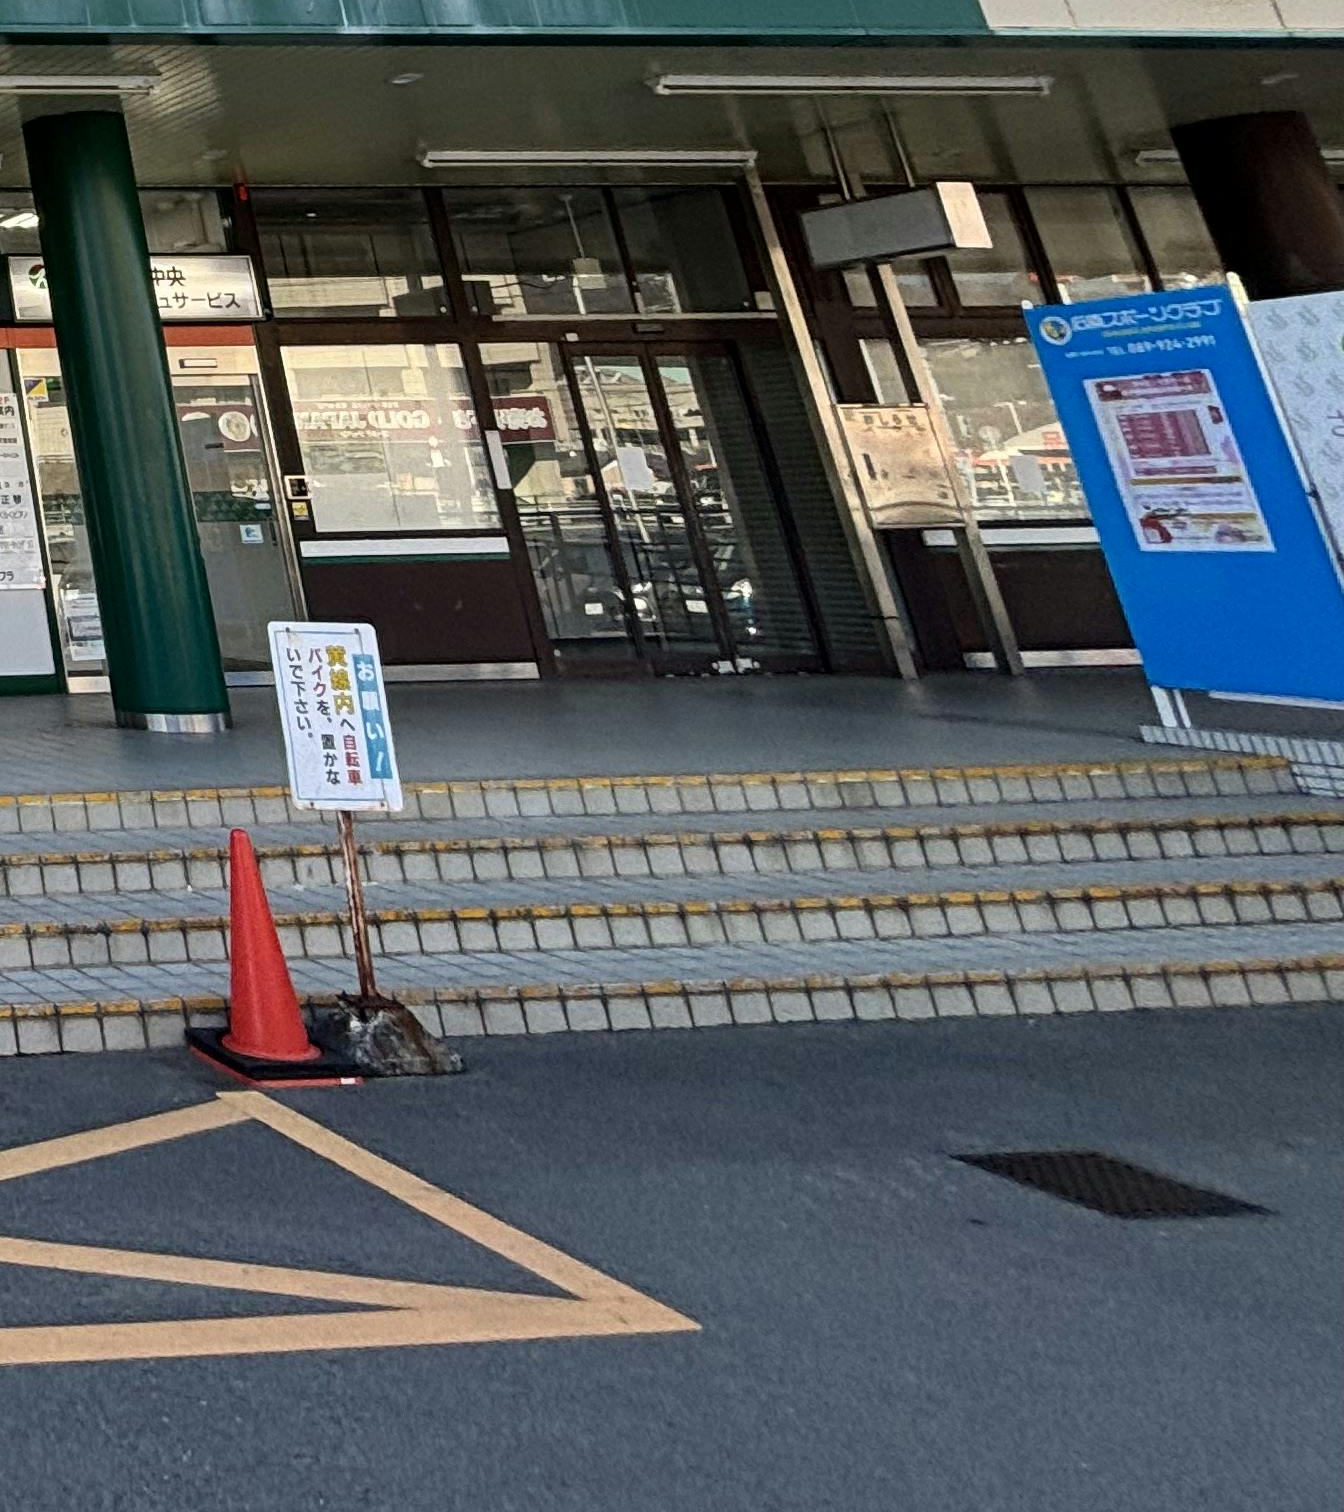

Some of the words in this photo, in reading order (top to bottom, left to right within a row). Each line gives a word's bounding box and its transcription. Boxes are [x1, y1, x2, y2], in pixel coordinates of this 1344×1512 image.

[325, 644, 362, 785] 黄線内へ自転車
